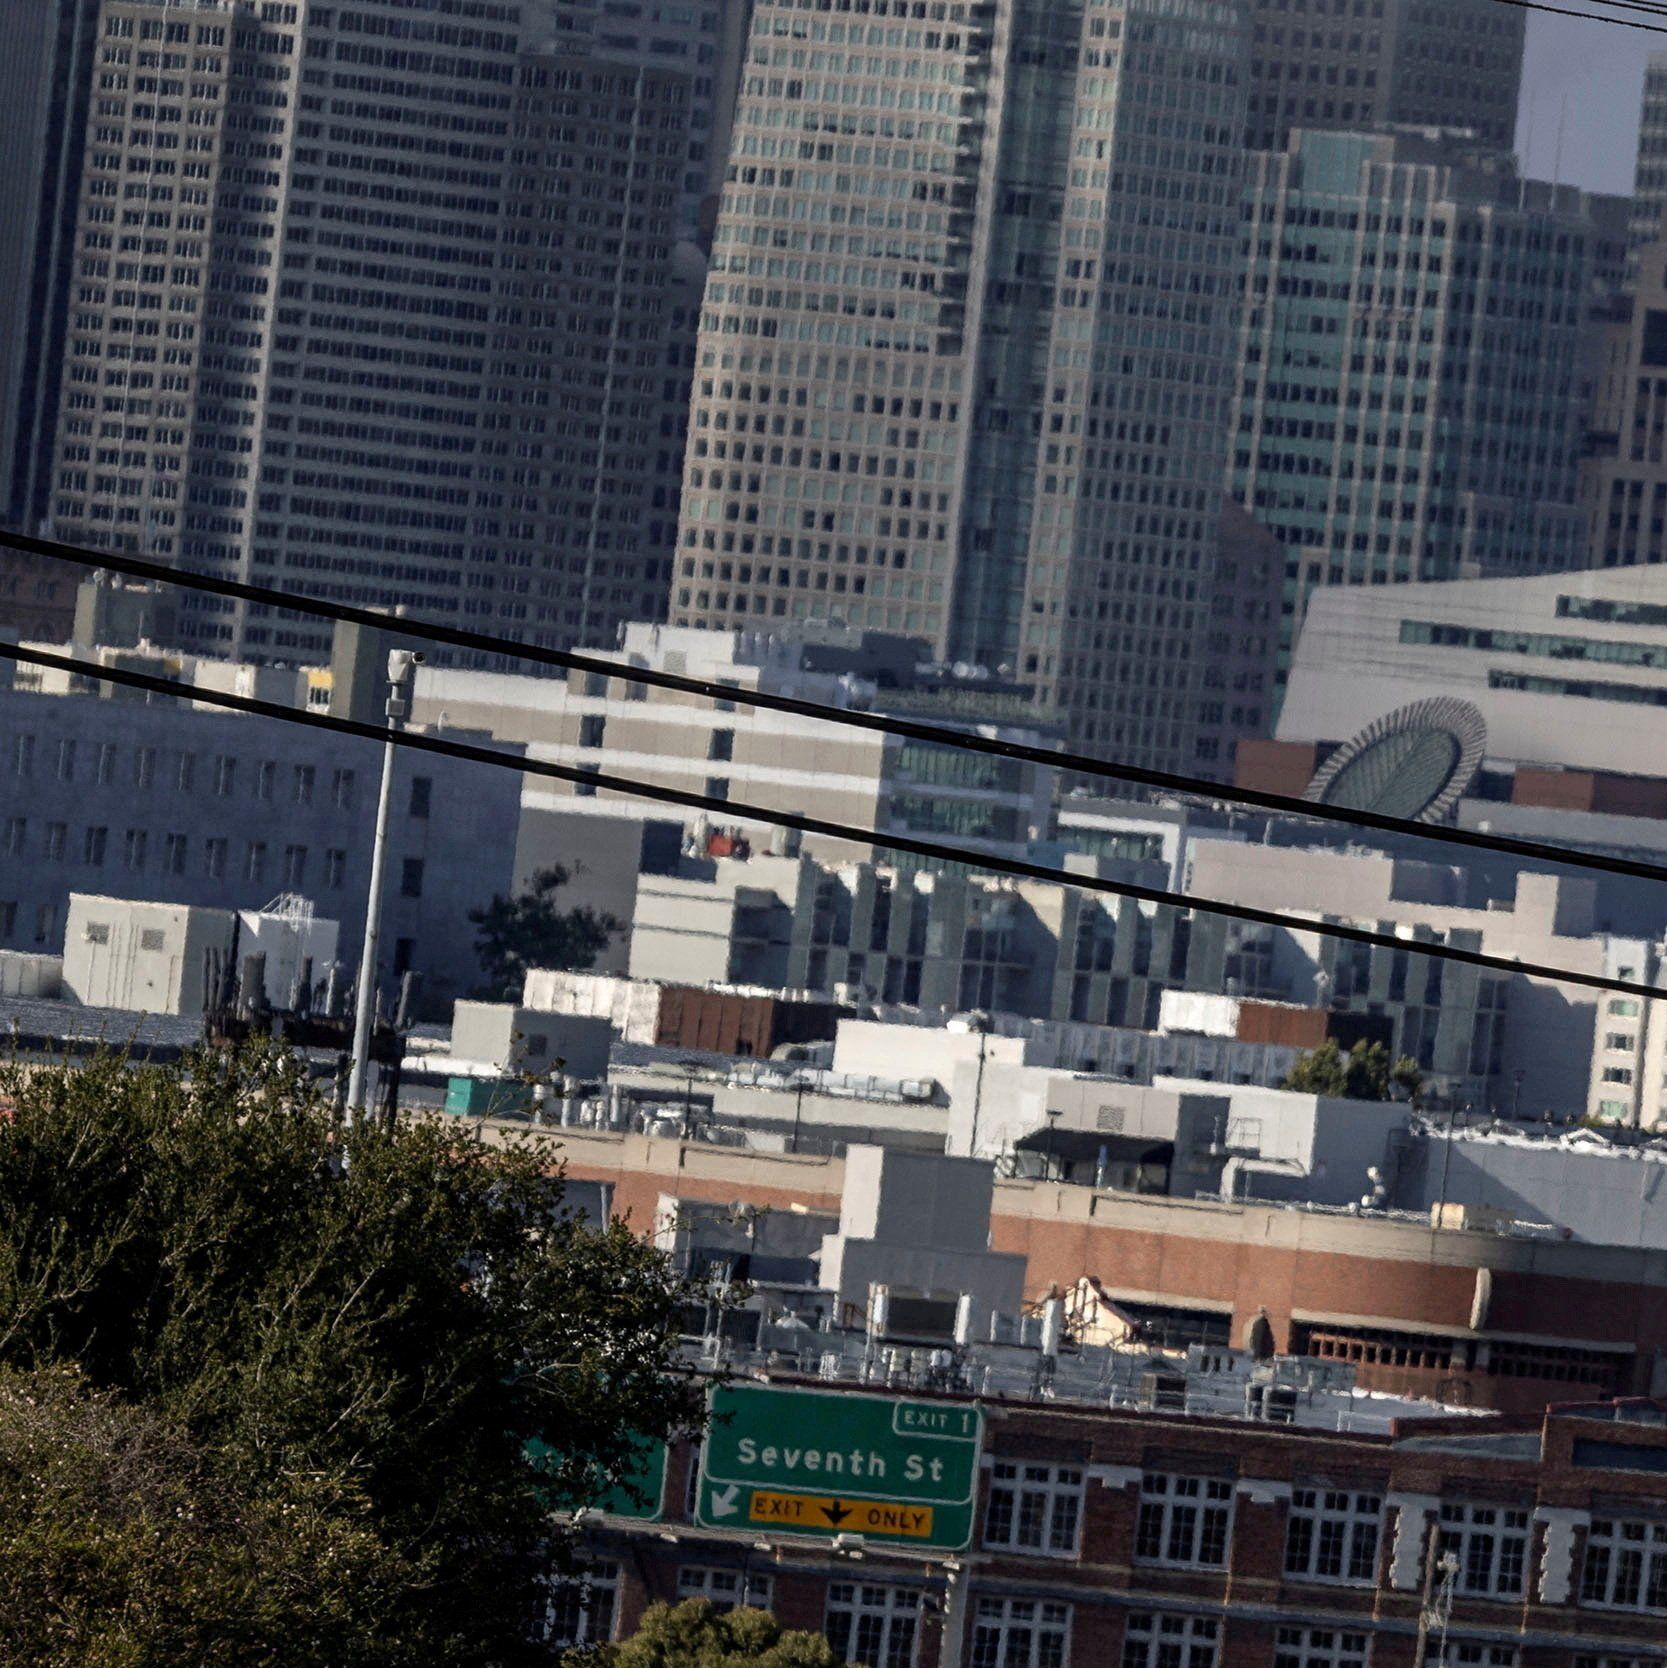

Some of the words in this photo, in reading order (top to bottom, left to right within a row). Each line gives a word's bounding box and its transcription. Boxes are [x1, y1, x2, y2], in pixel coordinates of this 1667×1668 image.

[904, 1409, 949, 1429] EXIT
[961, 1413, 969, 1433] 1
[737, 1437, 886, 1479] Seventh
[904, 1454, 944, 1482] St
[754, 1497, 804, 1518] EXIT
[868, 1508, 927, 1531] ONLY
